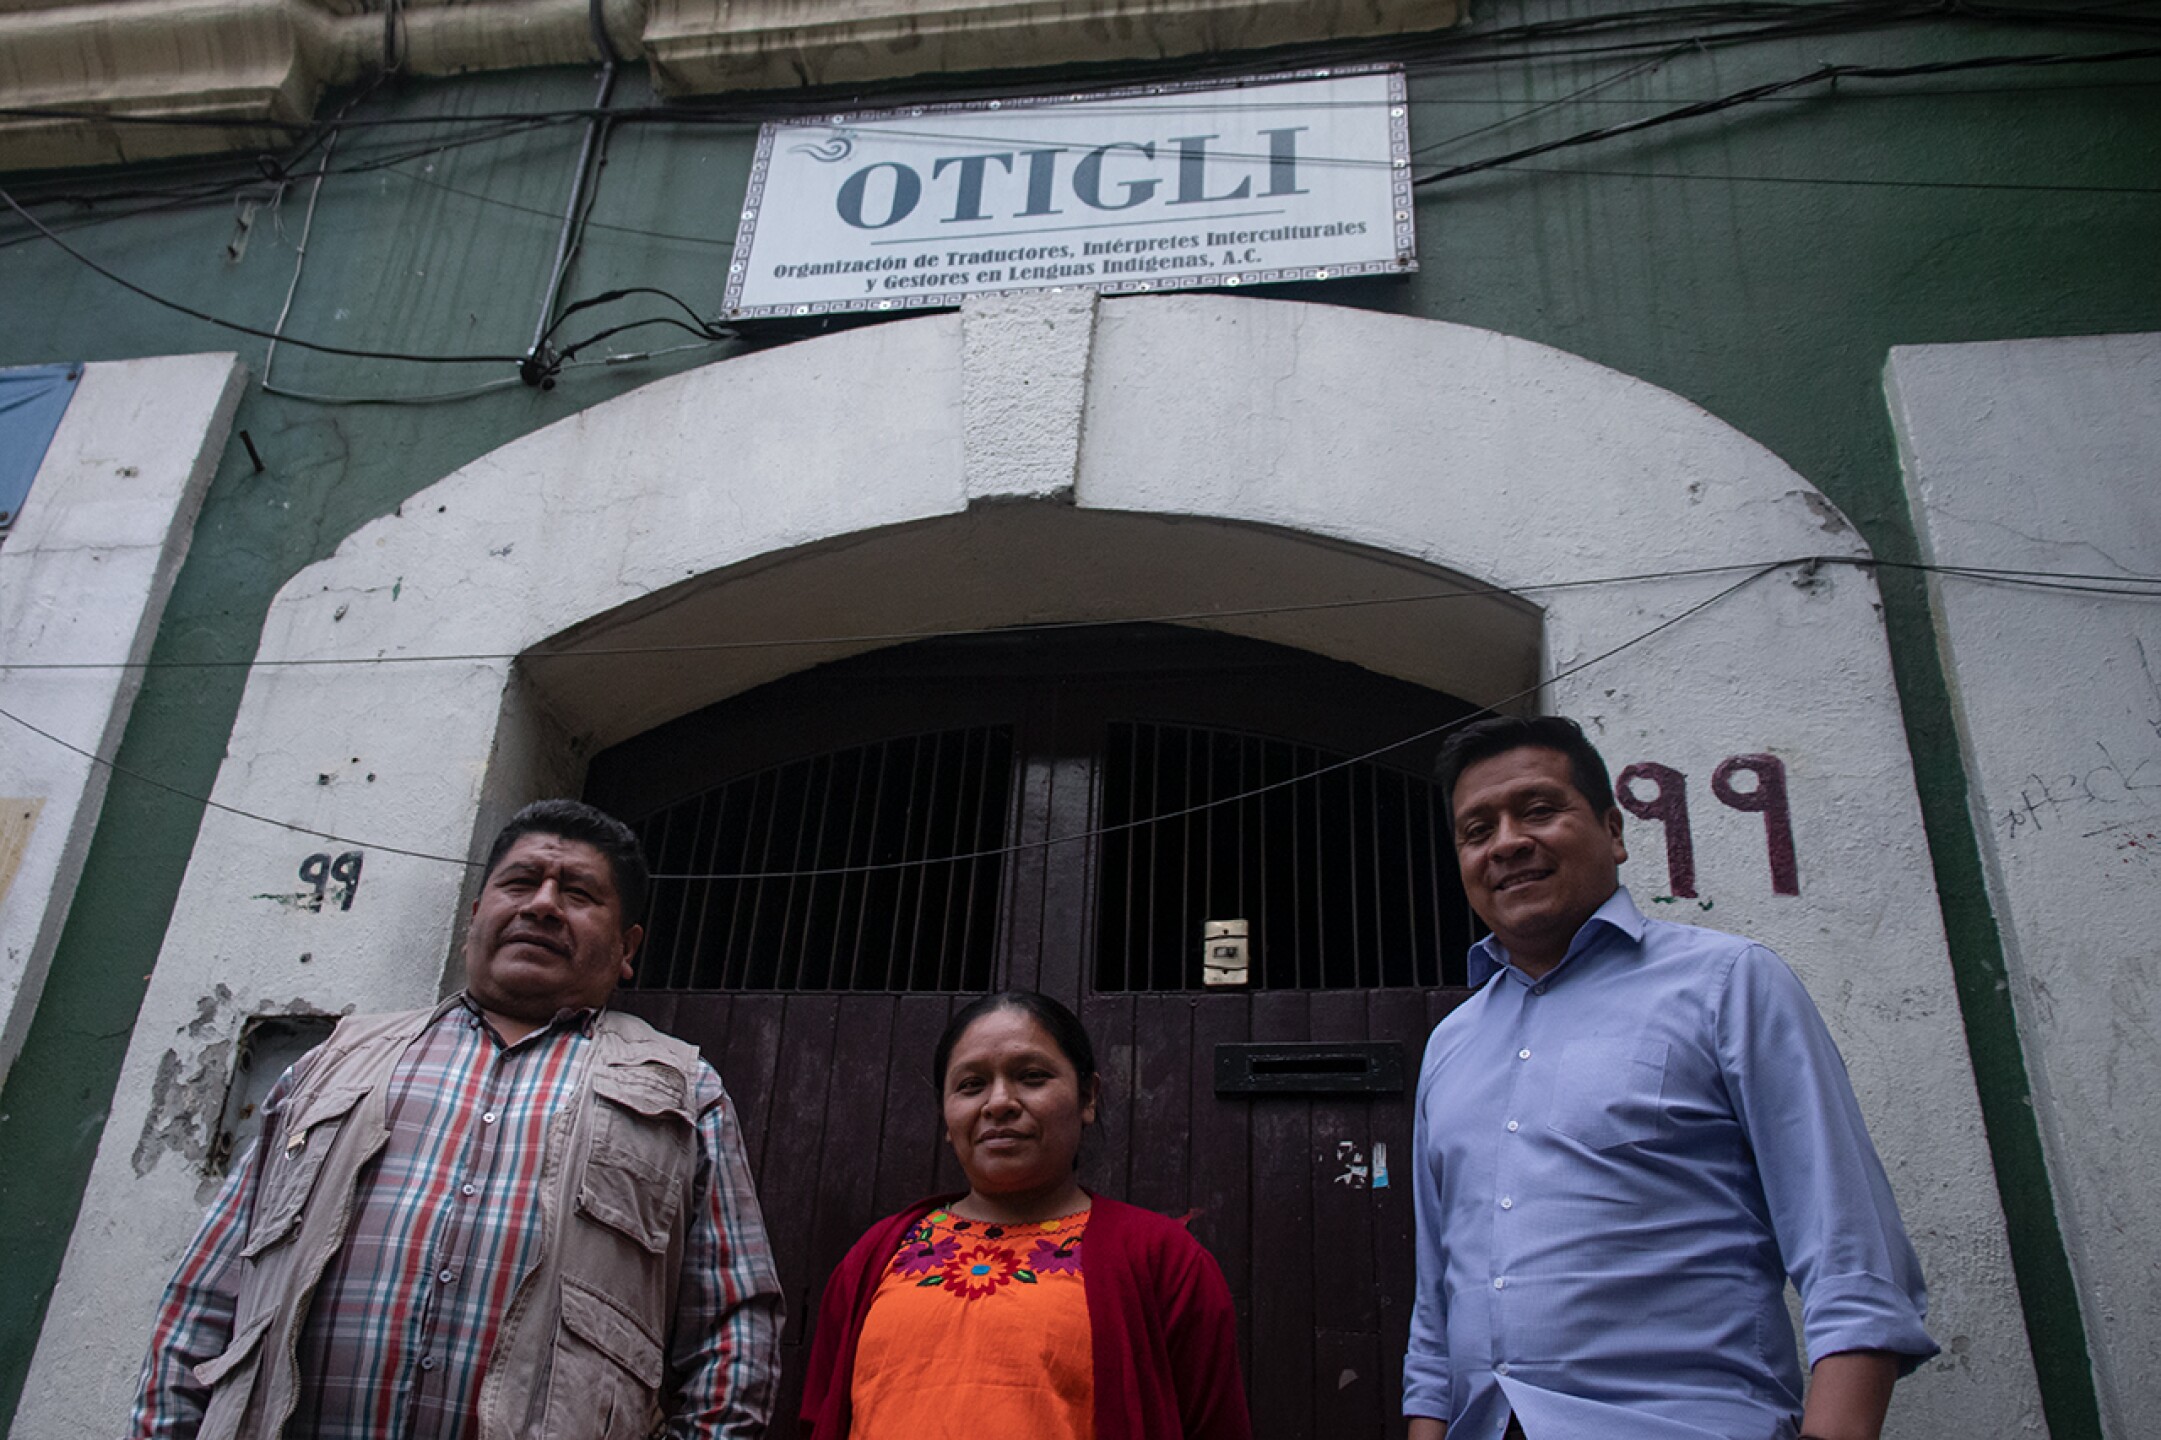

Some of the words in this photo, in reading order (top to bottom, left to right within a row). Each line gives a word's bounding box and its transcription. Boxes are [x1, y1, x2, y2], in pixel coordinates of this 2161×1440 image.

[836, 126, 1310, 230] OTIGLI
[773, 255, 907, 279] Organización
[914, 253, 939, 269] de
[946, 244, 1075, 267] Traductores,
[1083, 235, 1200, 257] Intérpretes
[1206, 220, 1368, 247] Interculturales
[864, 276, 877, 293] y
[884, 271, 970, 290] Gestores
[976, 269, 1002, 283] en
[1009, 260, 1095, 281] Lenguas
[1103, 253, 1215, 275] Indígenas,
[1222, 248, 1262, 266] A.C.
[1615, 753, 1799, 899] 99
[299, 850, 364, 913] 99
